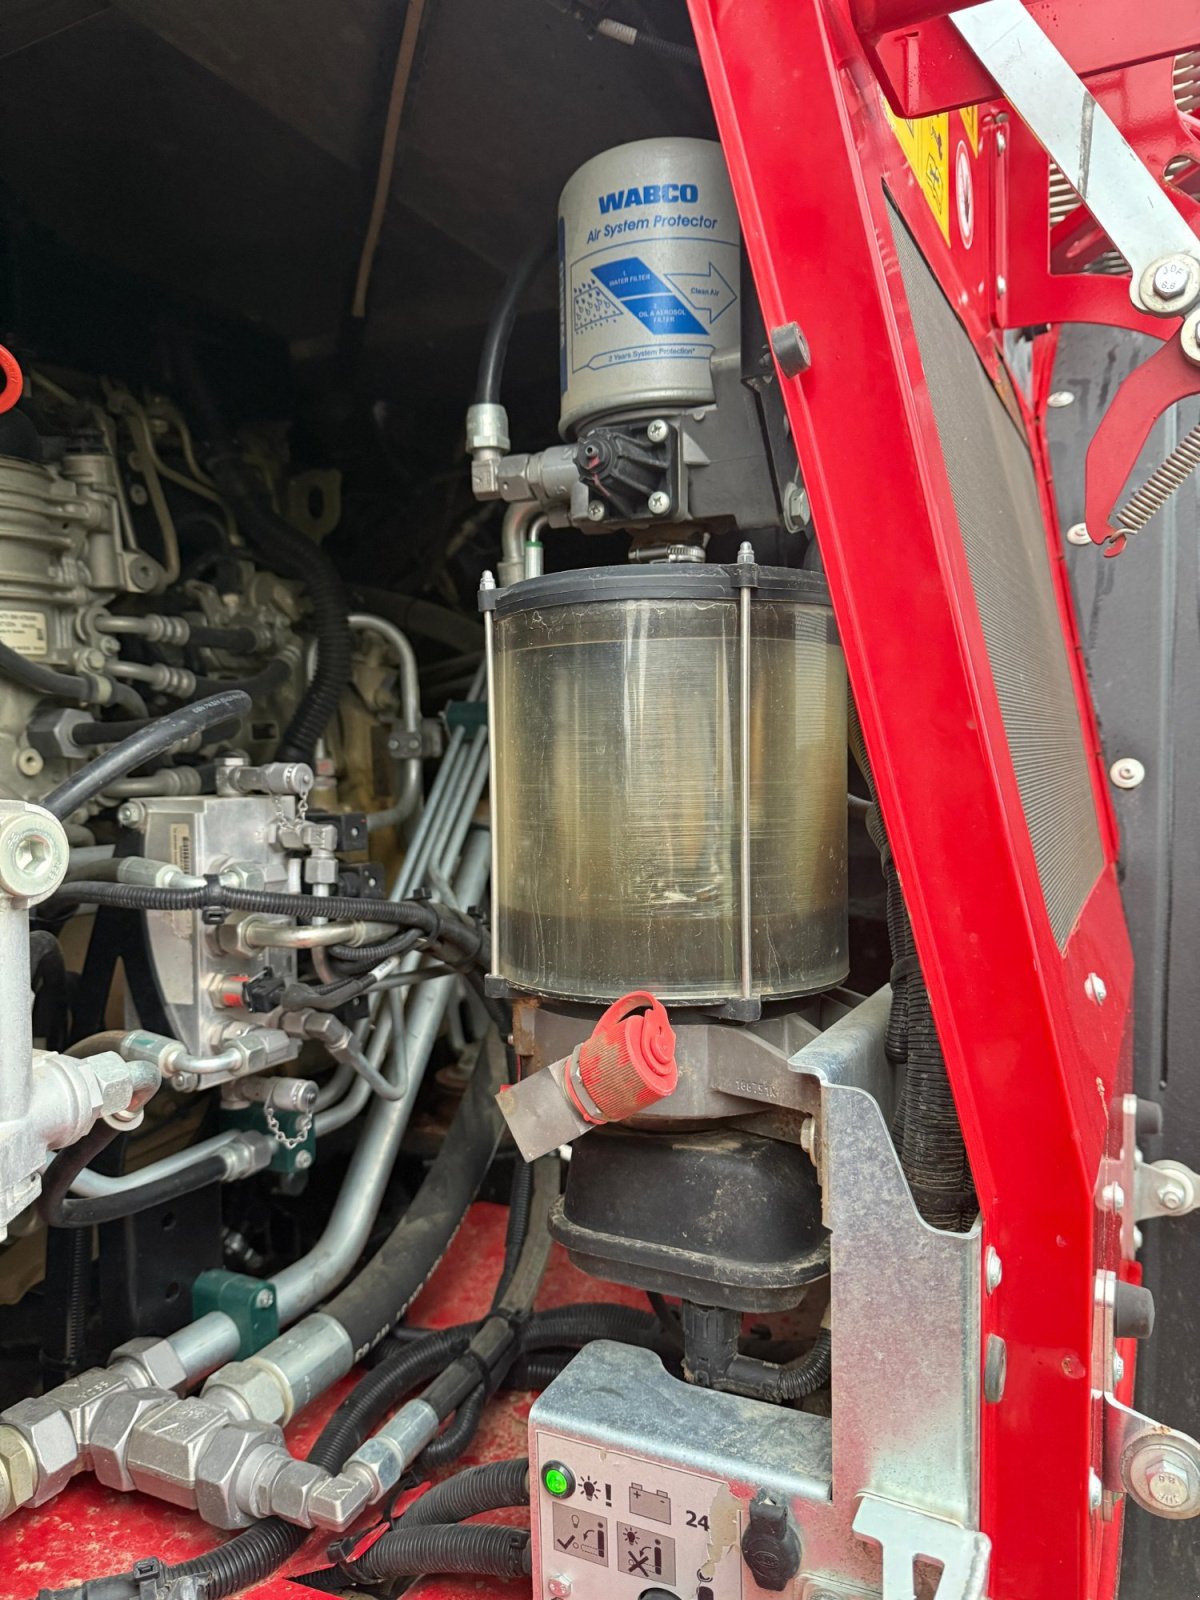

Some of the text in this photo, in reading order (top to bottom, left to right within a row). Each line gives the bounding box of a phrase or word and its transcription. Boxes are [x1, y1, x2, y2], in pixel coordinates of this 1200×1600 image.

[598, 183, 699, 215] WABCO
[586, 214, 718, 244] Air System Protector
[630, 273, 651, 283] FILTER
[690, 287, 720, 297] Clean Air
[614, 351, 632, 361] Years
[633, 349, 658, 360] System
[685, 1510, 711, 1532] 24
